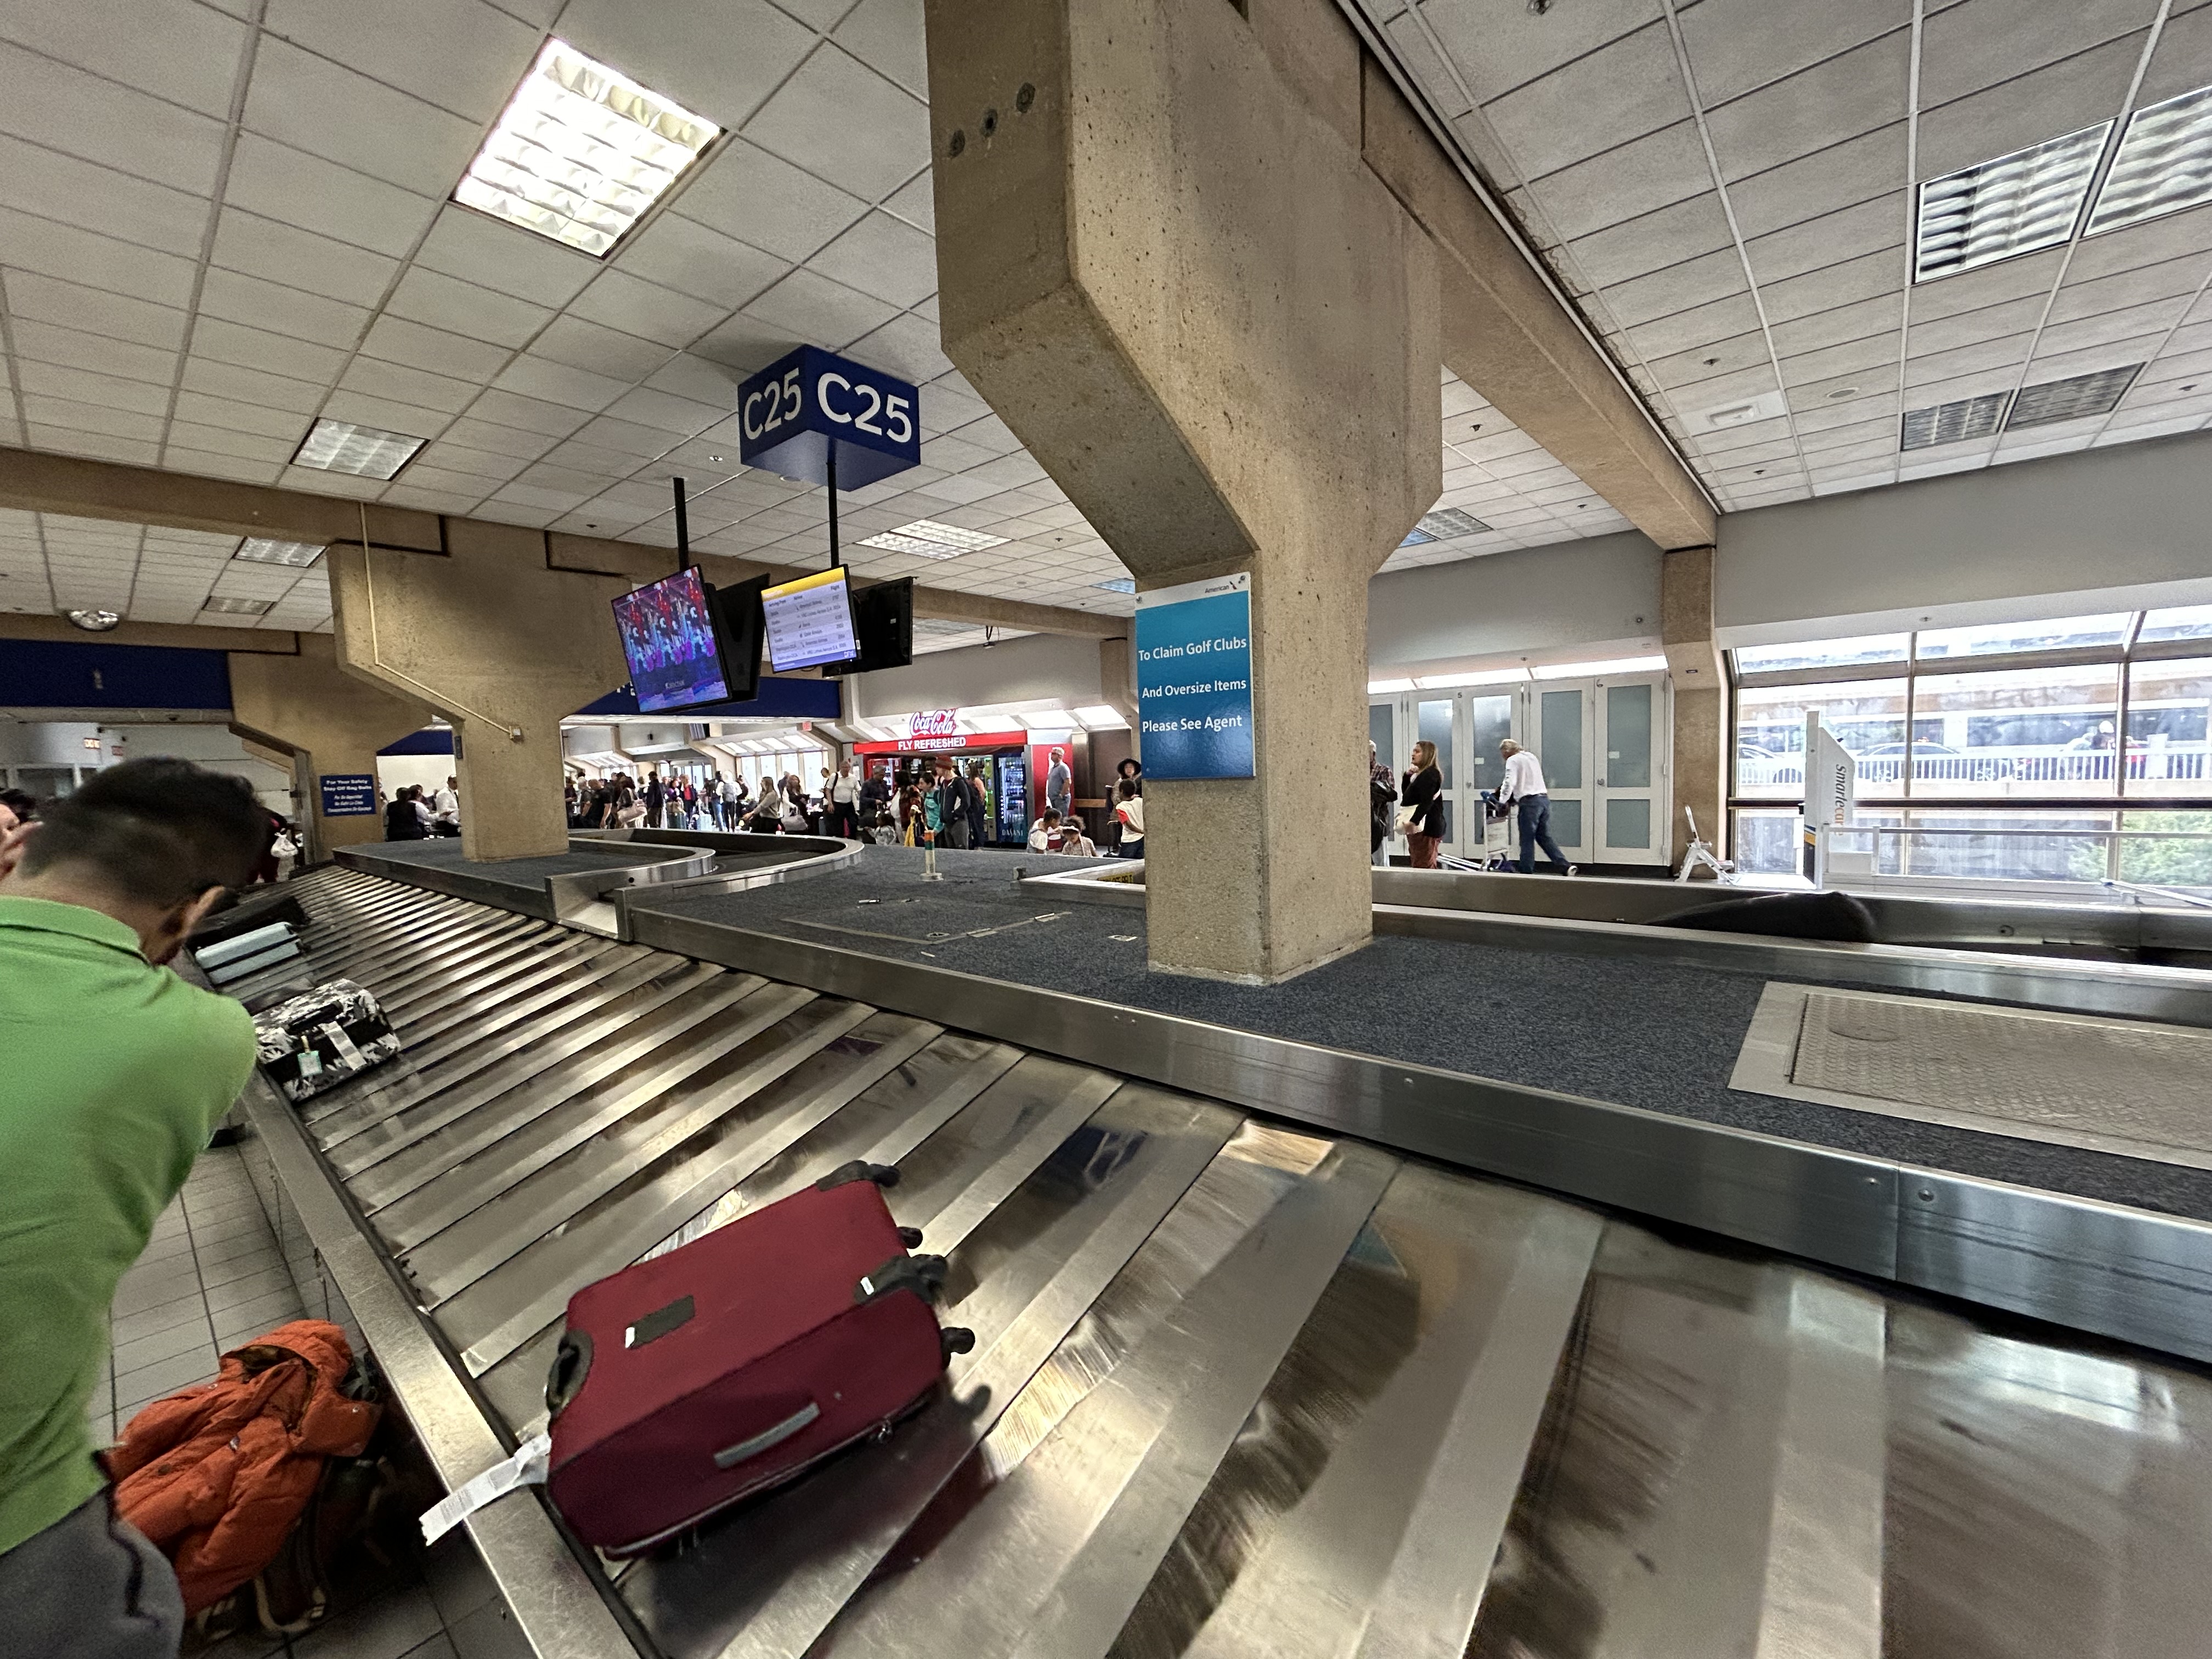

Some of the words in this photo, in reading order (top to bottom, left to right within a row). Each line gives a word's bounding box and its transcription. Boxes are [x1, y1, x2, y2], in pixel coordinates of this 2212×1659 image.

[744, 367, 802, 440] C25
[817, 372, 912, 443] C25
[1205, 585, 1229, 593] American
[1138, 650, 1150, 661] To
[1153, 645, 1183, 659] Claim
[1186, 640, 1211, 654] Golf
[1214, 636, 1247, 651] Clubs
[1142, 686, 1162, 698] And
[1165, 681, 1211, 696] Oversize
[1214, 680, 1246, 692] Items
[1142, 720, 1177, 732] Please
[1180, 718, 1201, 730] See
[1204, 715, 1243, 732] Agent
[898, 741, 912, 751] FLY
[914, 736, 966, 749] REFRESHED
[1002, 828, 1023, 837] DASANI
